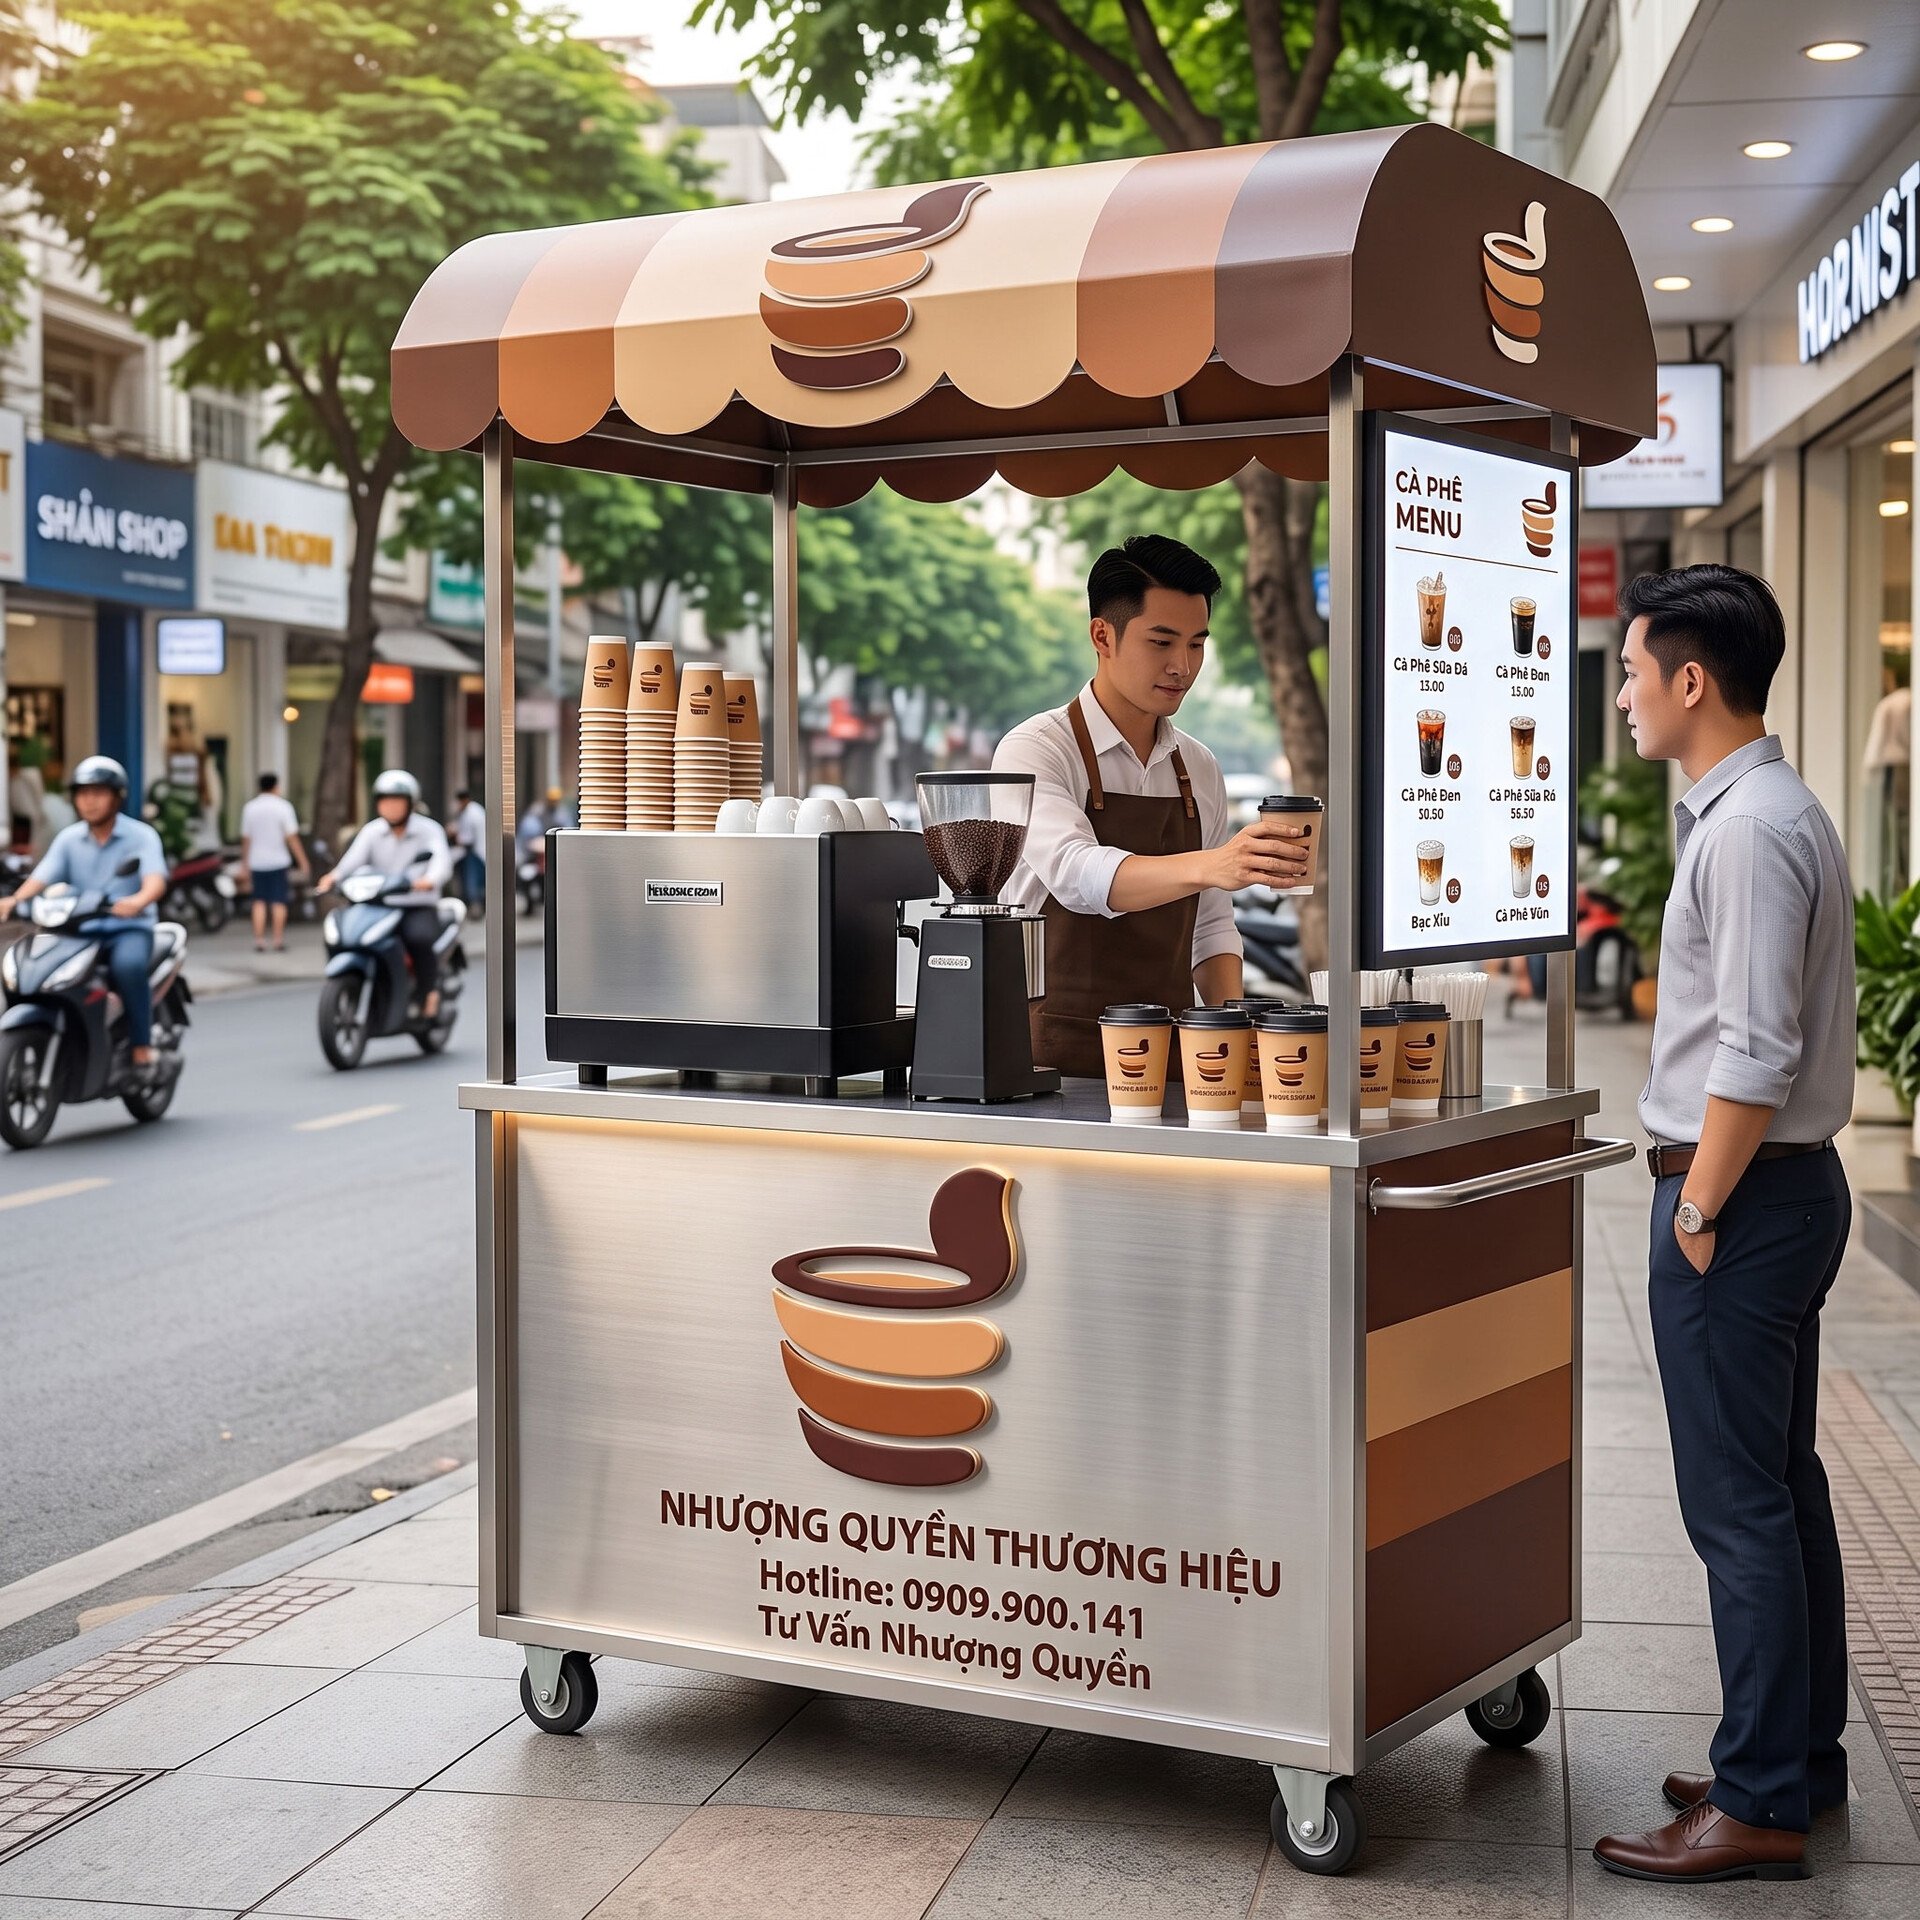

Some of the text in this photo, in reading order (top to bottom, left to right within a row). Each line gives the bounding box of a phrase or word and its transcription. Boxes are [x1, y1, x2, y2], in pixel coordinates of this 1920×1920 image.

[1395, 466, 1462, 502] CÀ PHÊ
[1396, 502, 1462, 539] MENU
[117, 510, 188, 560] SHOP
[1394, 657, 1408, 672] Cà
[1410, 659, 1431, 674] Phê
[1420, 680, 1444, 692] 13.00
[1511, 686, 1534, 698] 15.00
[1401, 788, 1414, 801] Cà
[1440, 788, 1461, 802] Đen
[1489, 788, 1501, 802] Cà
[1411, 915, 1431, 932] Bạc
[1495, 909, 1508, 922] Cà
[661, 1490, 1281, 1605] NHƯỢNG QUYỀN THƯƠNG HIỆU
[760, 1559, 1143, 1640] Hotline: 0909.900.141
[758, 1604, 1151, 1692] Tư Vấn Nhượng Quyền
